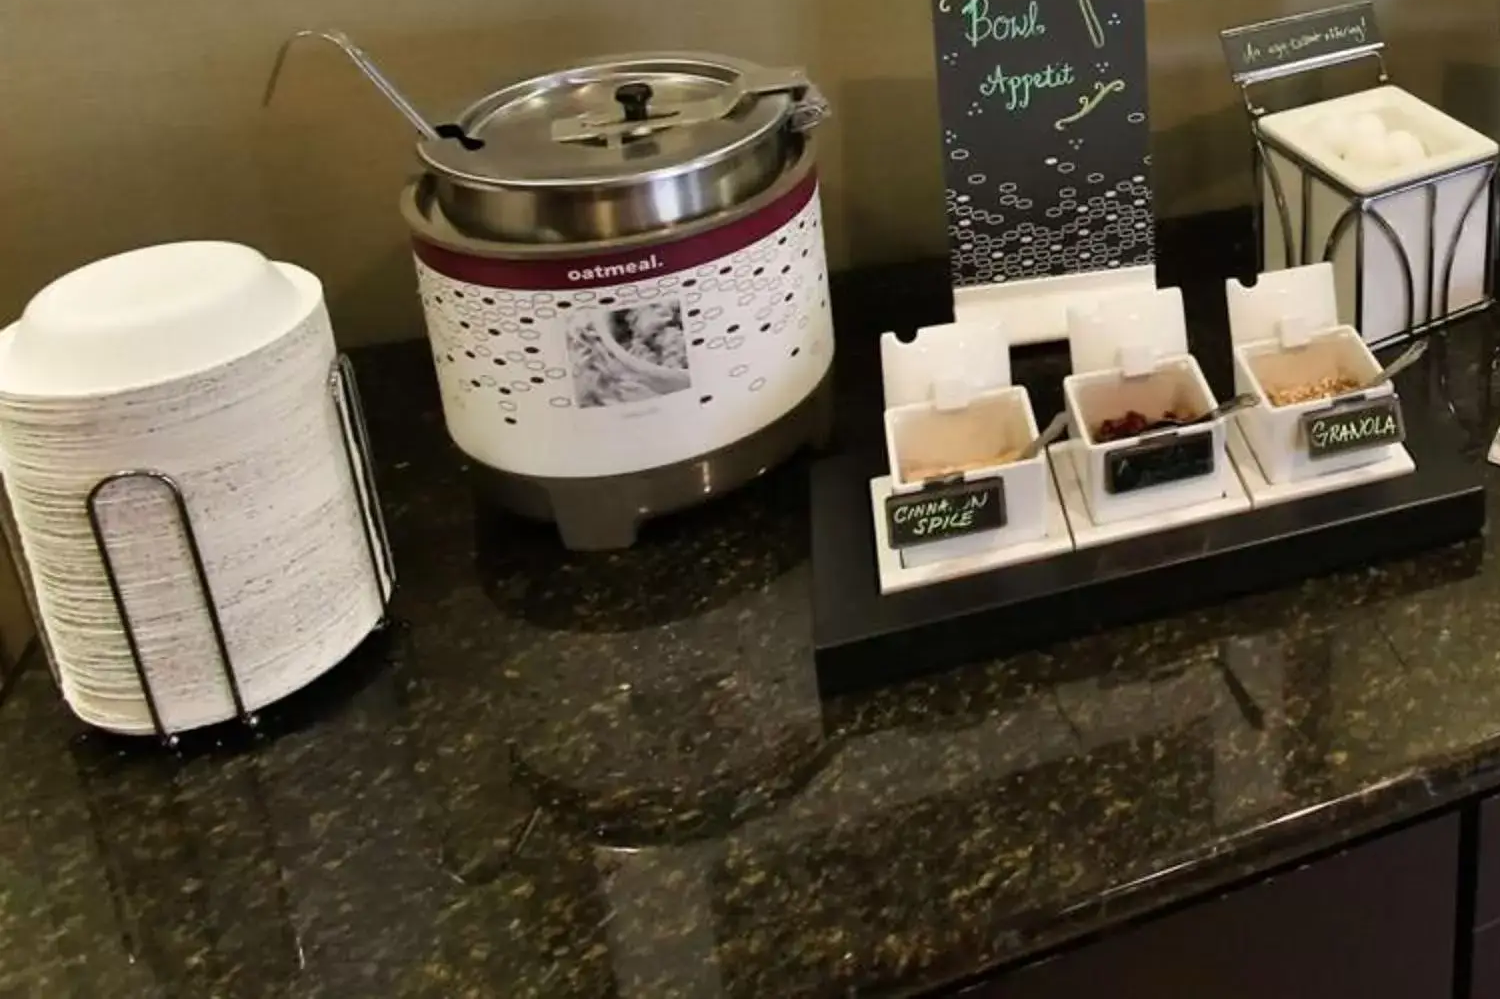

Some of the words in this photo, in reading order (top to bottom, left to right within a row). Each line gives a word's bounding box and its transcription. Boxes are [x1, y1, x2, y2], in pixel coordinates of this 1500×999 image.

[567, 254, 664, 281] oatmeal.
[1311, 414, 1396, 449] GRANOLA
[913, 510, 974, 535] SPICE
